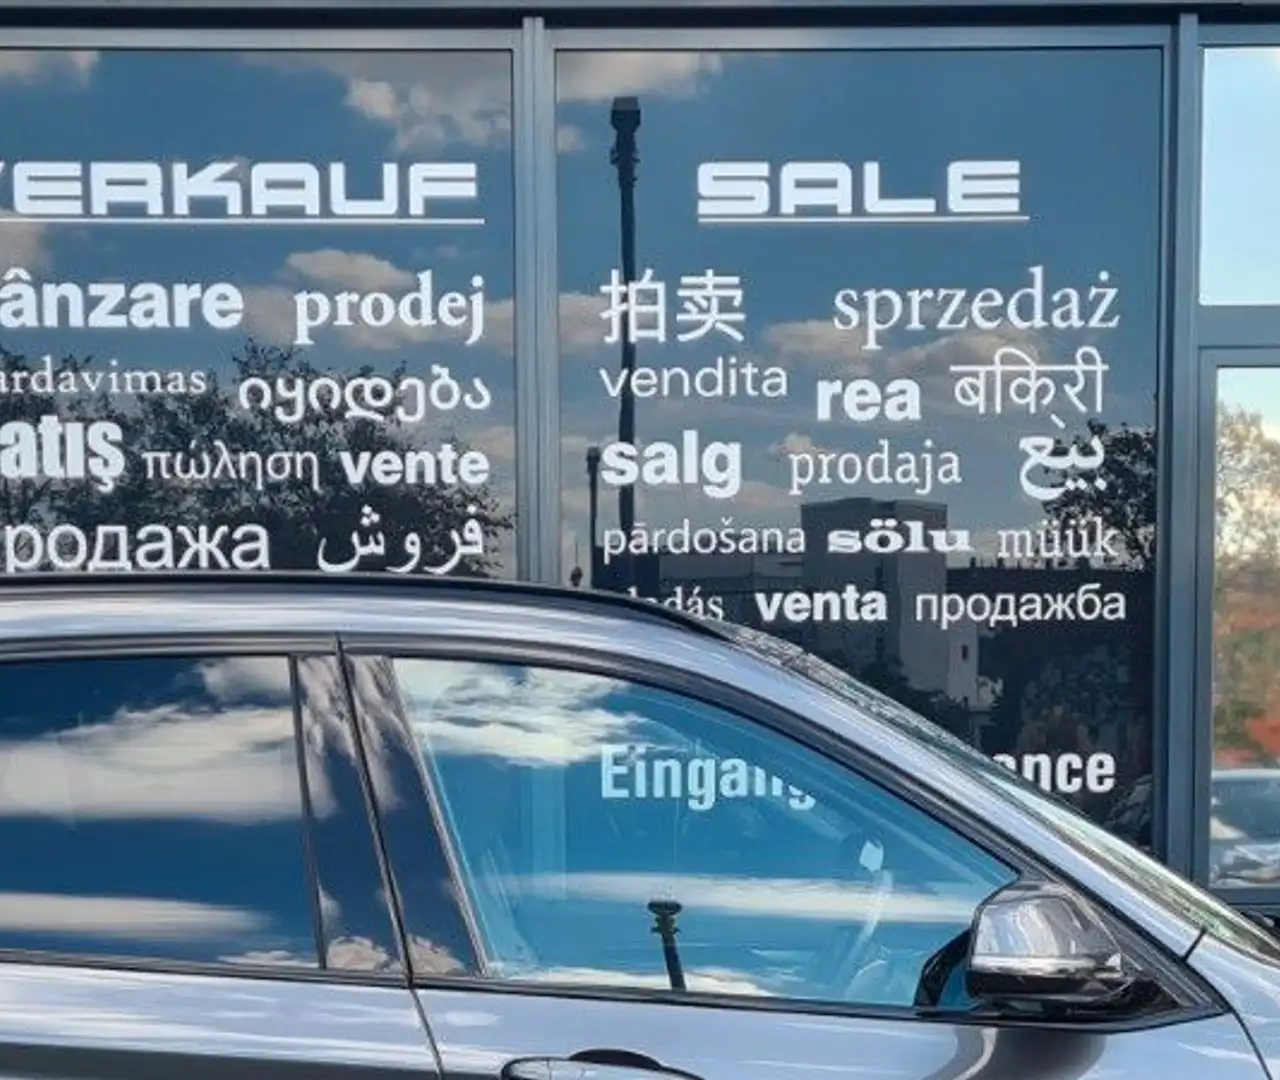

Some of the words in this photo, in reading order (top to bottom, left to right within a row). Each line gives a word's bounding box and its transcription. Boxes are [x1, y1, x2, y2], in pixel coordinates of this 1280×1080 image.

[697, 160, 1021, 214] SALE
[293, 270, 484, 345] prodej
[599, 268, 746, 344] 拍卖
[832, 265, 1121, 350] sprzedaż
[239, 364, 491, 423] იყიდება
[599, 356, 788, 398] vendita
[816, 377, 921, 421] rea
[140, 440, 321, 492] πώληση
[340, 444, 491, 485] vente
[600, 430, 742, 498] salg
[788, 438, 962, 496] prodaja
[317, 504, 485, 575] فروش
[602, 517, 806, 565] pārdošana
[827, 518, 974, 554] sölu
[996, 515, 1120, 560] müük
[754, 584, 888, 622] venta
[915, 582, 1126, 631] продажба
